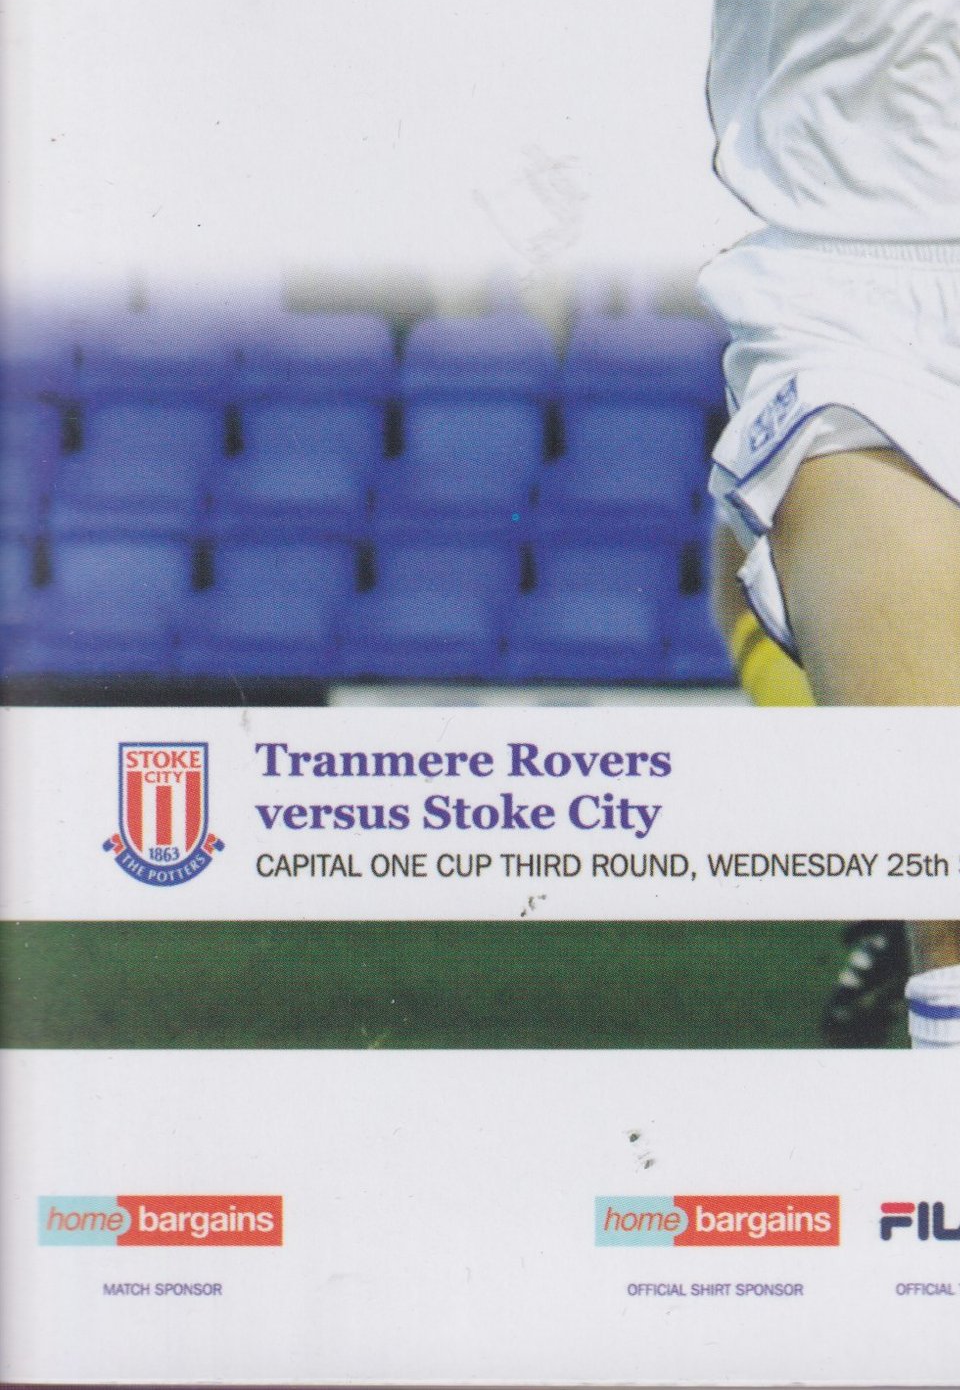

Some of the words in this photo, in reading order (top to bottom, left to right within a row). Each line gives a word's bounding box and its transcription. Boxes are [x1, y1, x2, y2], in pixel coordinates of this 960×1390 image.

[126, 750, 202, 768] STOKE
[255, 743, 493, 778] Tranmere
[507, 743, 672, 778] Rovers
[144, 771, 182, 783] CITY
[255, 804, 410, 830] versus
[423, 793, 555, 830] Stoke
[568, 793, 662, 839] City
[148, 847, 180, 861] 1863
[122, 856, 146, 876] THE
[148, 855, 206, 882] POTTERS
[256, 853, 362, 877] CAPITAL
[370, 853, 427, 878] ONE
[437, 853, 492, 878] CUP
[500, 853, 582, 877] THIRD
[592, 853, 696, 882] ROUND,
[707, 853, 878, 877] WEDNESDAY
[888, 853, 949, 877] 25th
[47, 1207, 123, 1231] home
[139, 1205, 275, 1238] bargains
[604, 1206, 682, 1231] home
[696, 1205, 832, 1238] bargains
[103, 1283, 150, 1296] MATCH
[155, 1283, 222, 1296] SPONSOR
[627, 1283, 686, 1296] OFFICIAL
[691, 1283, 731, 1296] SHIRT
[736, 1283, 803, 1296] SPONSOR
[896, 1283, 954, 1296] OFFICIAL
